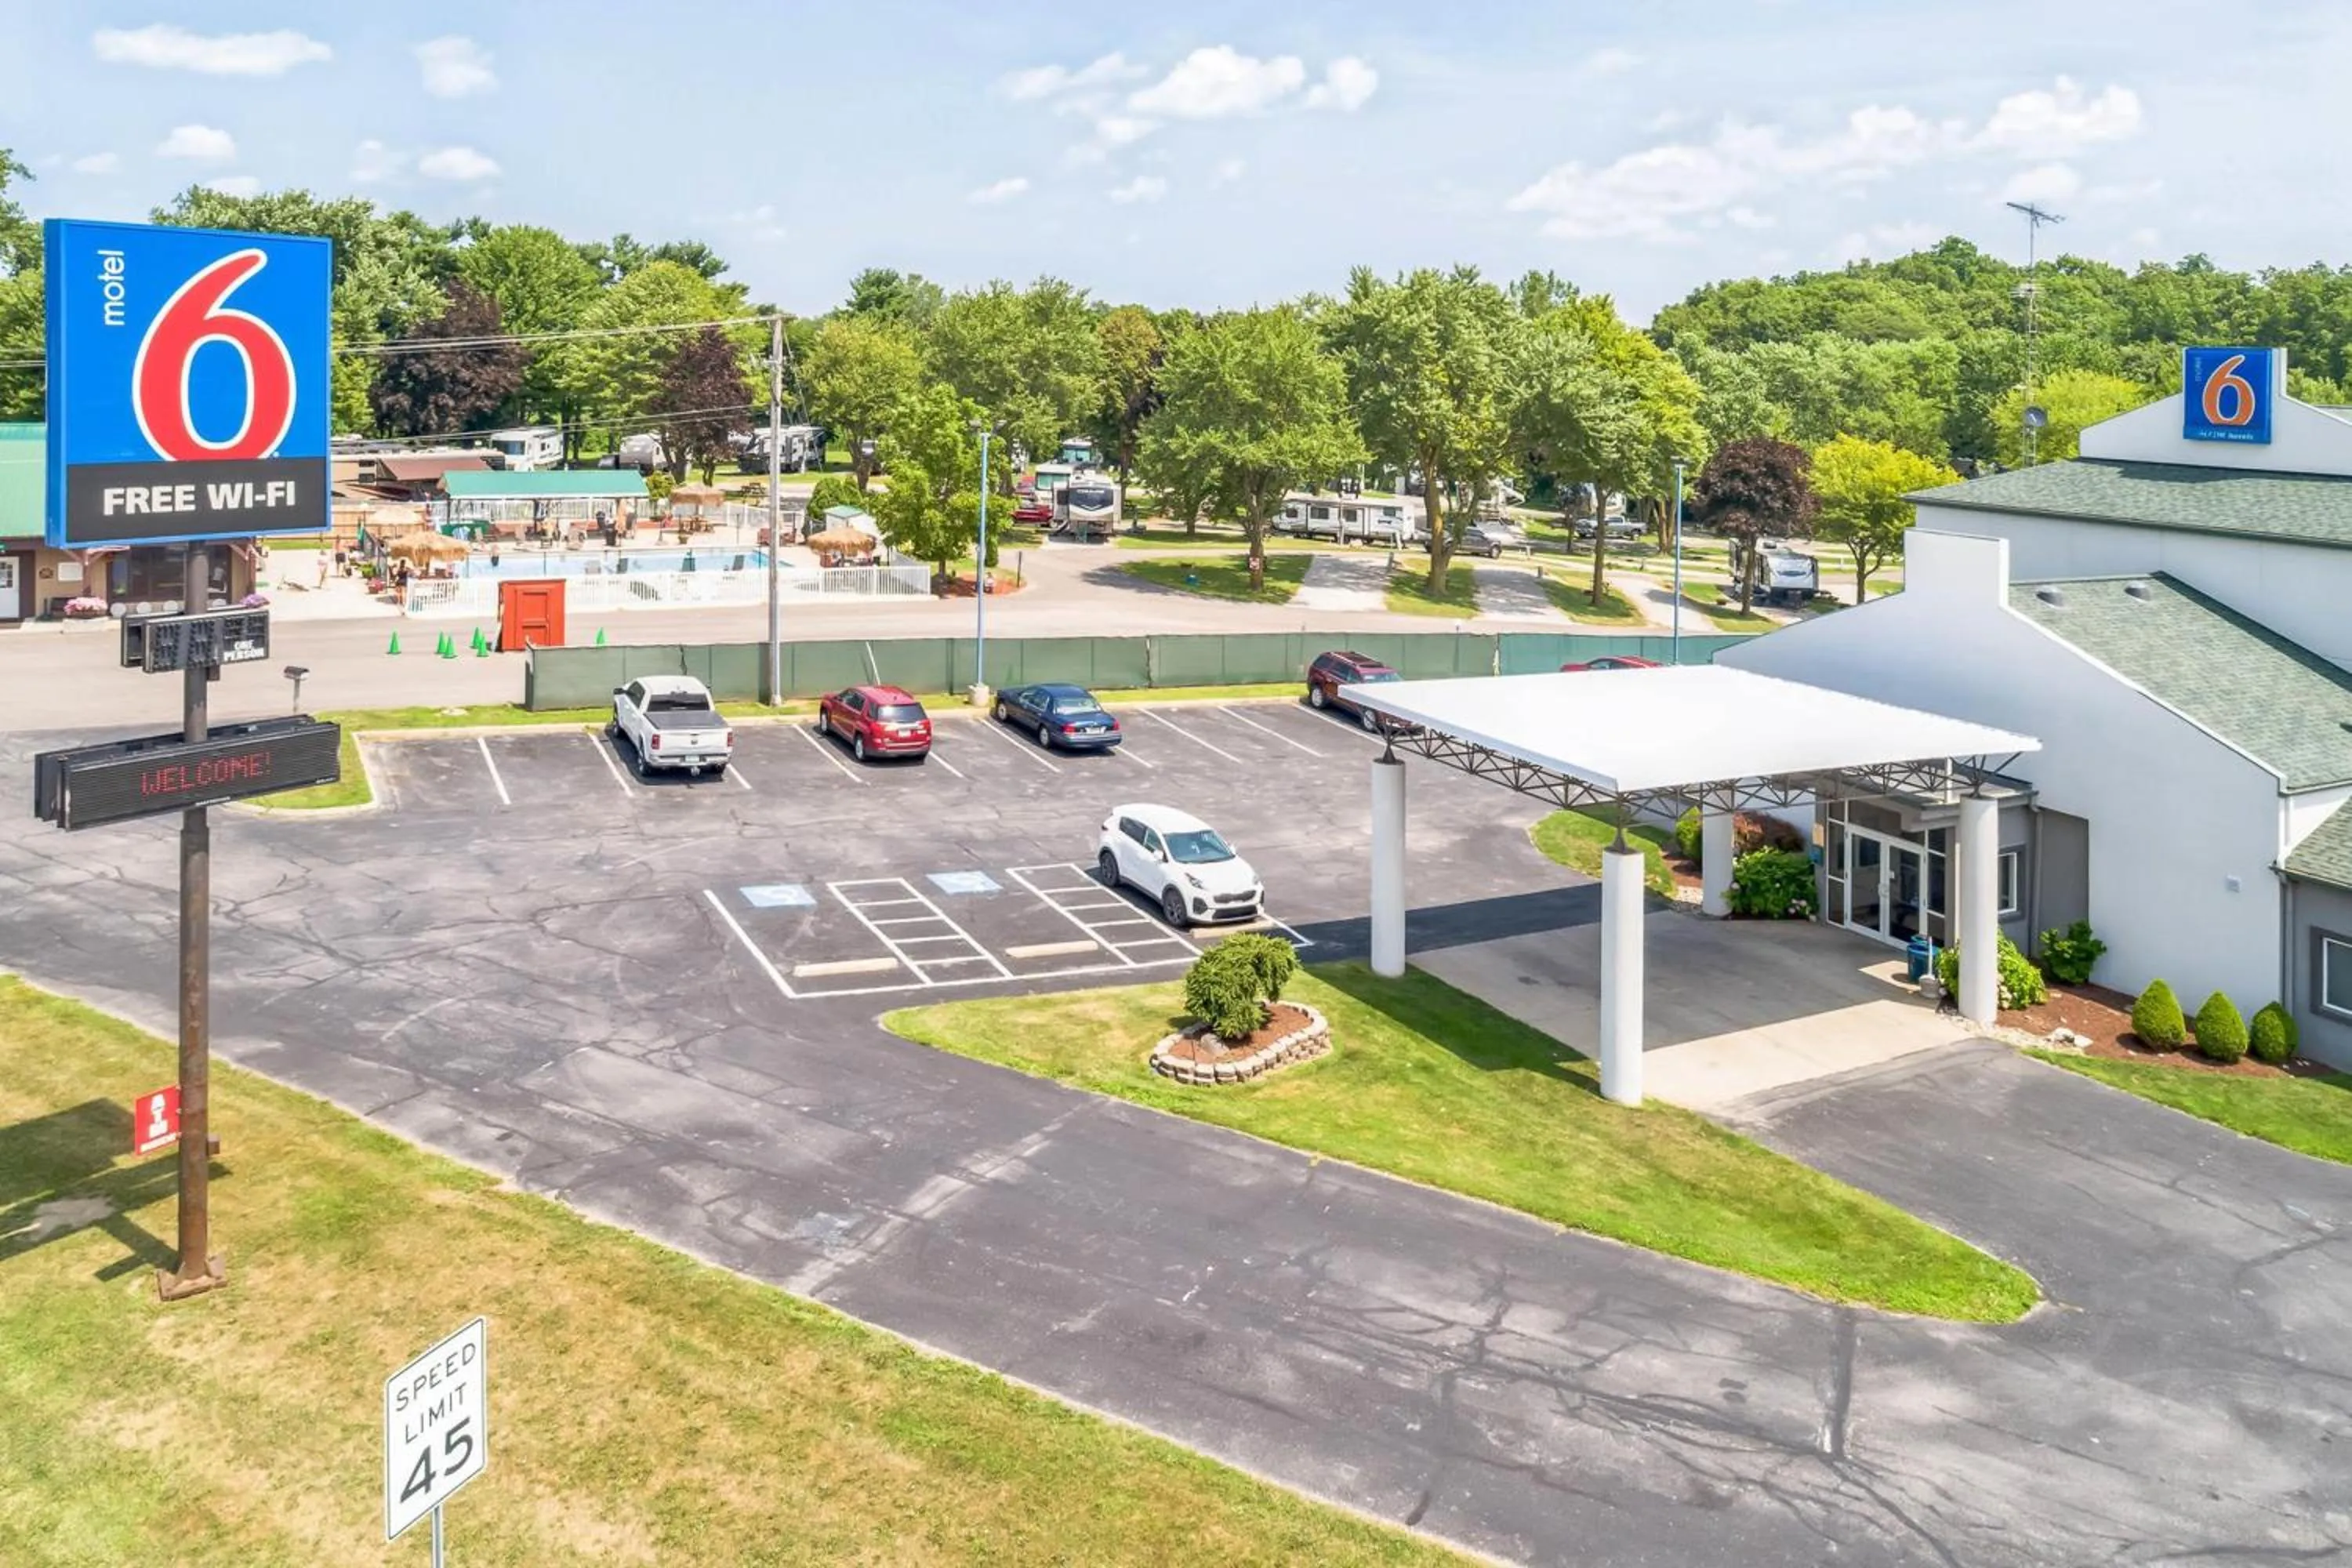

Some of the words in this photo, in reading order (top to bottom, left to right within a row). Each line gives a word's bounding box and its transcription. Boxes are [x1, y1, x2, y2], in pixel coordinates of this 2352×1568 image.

[96, 250, 125, 326] motel
[132, 248, 296, 461] 6
[2202, 354, 2255, 426] 6
[103, 485, 195, 515] FREE
[207, 481, 296, 511] WI-FI
[140, 752, 270, 800] WELCOME!
[396, 1342, 476, 1412] SPEED
[405, 1382, 466, 1444] LIMIT
[400, 1417, 474, 1503] 45
